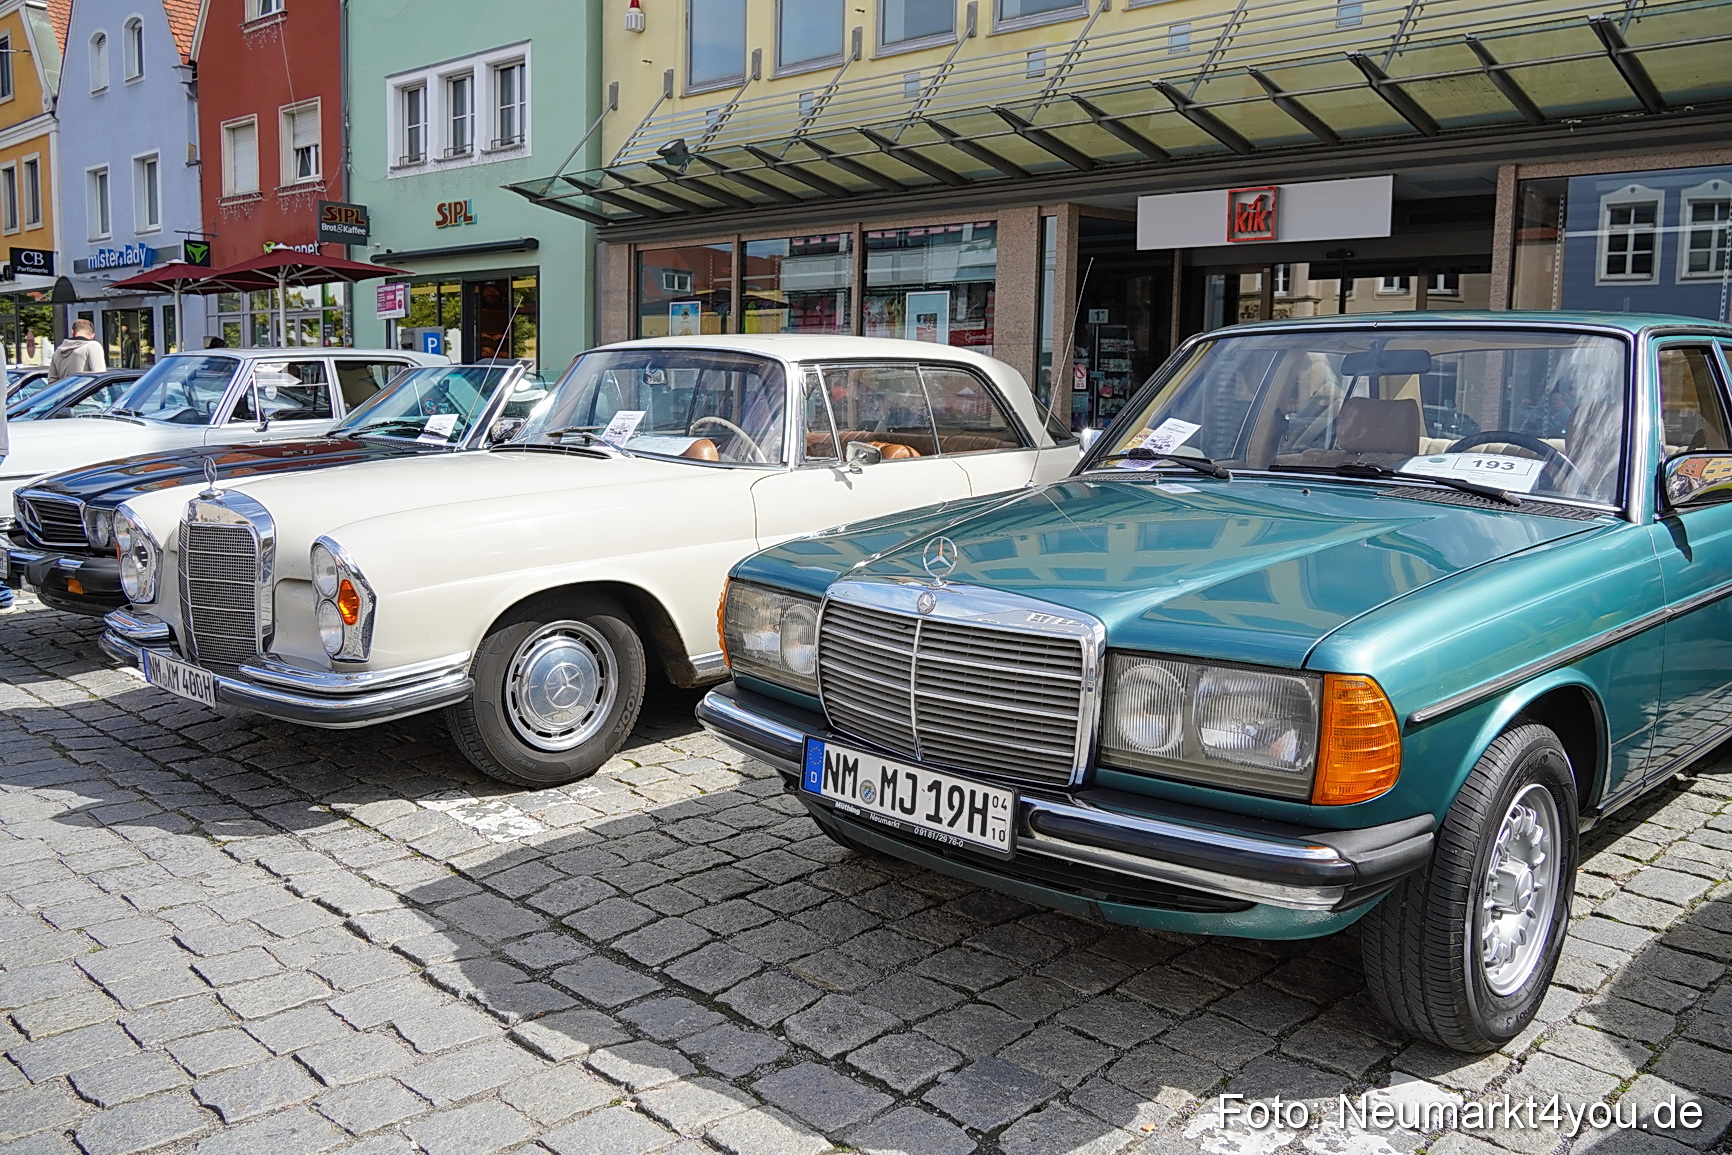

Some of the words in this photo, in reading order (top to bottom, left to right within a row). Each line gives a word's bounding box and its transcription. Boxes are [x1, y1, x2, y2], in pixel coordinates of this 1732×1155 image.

[321, 205, 366, 226] SIPL
[434, 199, 475, 229] SIPL
[20, 250, 45, 266] CB
[16, 265, 49, 274] Parfümerie
[427, 337, 438, 354] P
[1472, 459, 1516, 471] 193
[149, 654, 162, 684] NM
[165, 661, 180, 692] XM
[809, 771, 818, 783] D
[823, 750, 859, 799] NM
[879, 766, 918, 815] MJ
[926, 780, 990, 837] 19H
[992, 795, 1008, 811] 04
[835, 800, 861, 816] Müthing
[869, 813, 900, 829] Neumarkt
[992, 827, 1006, 842] 10
